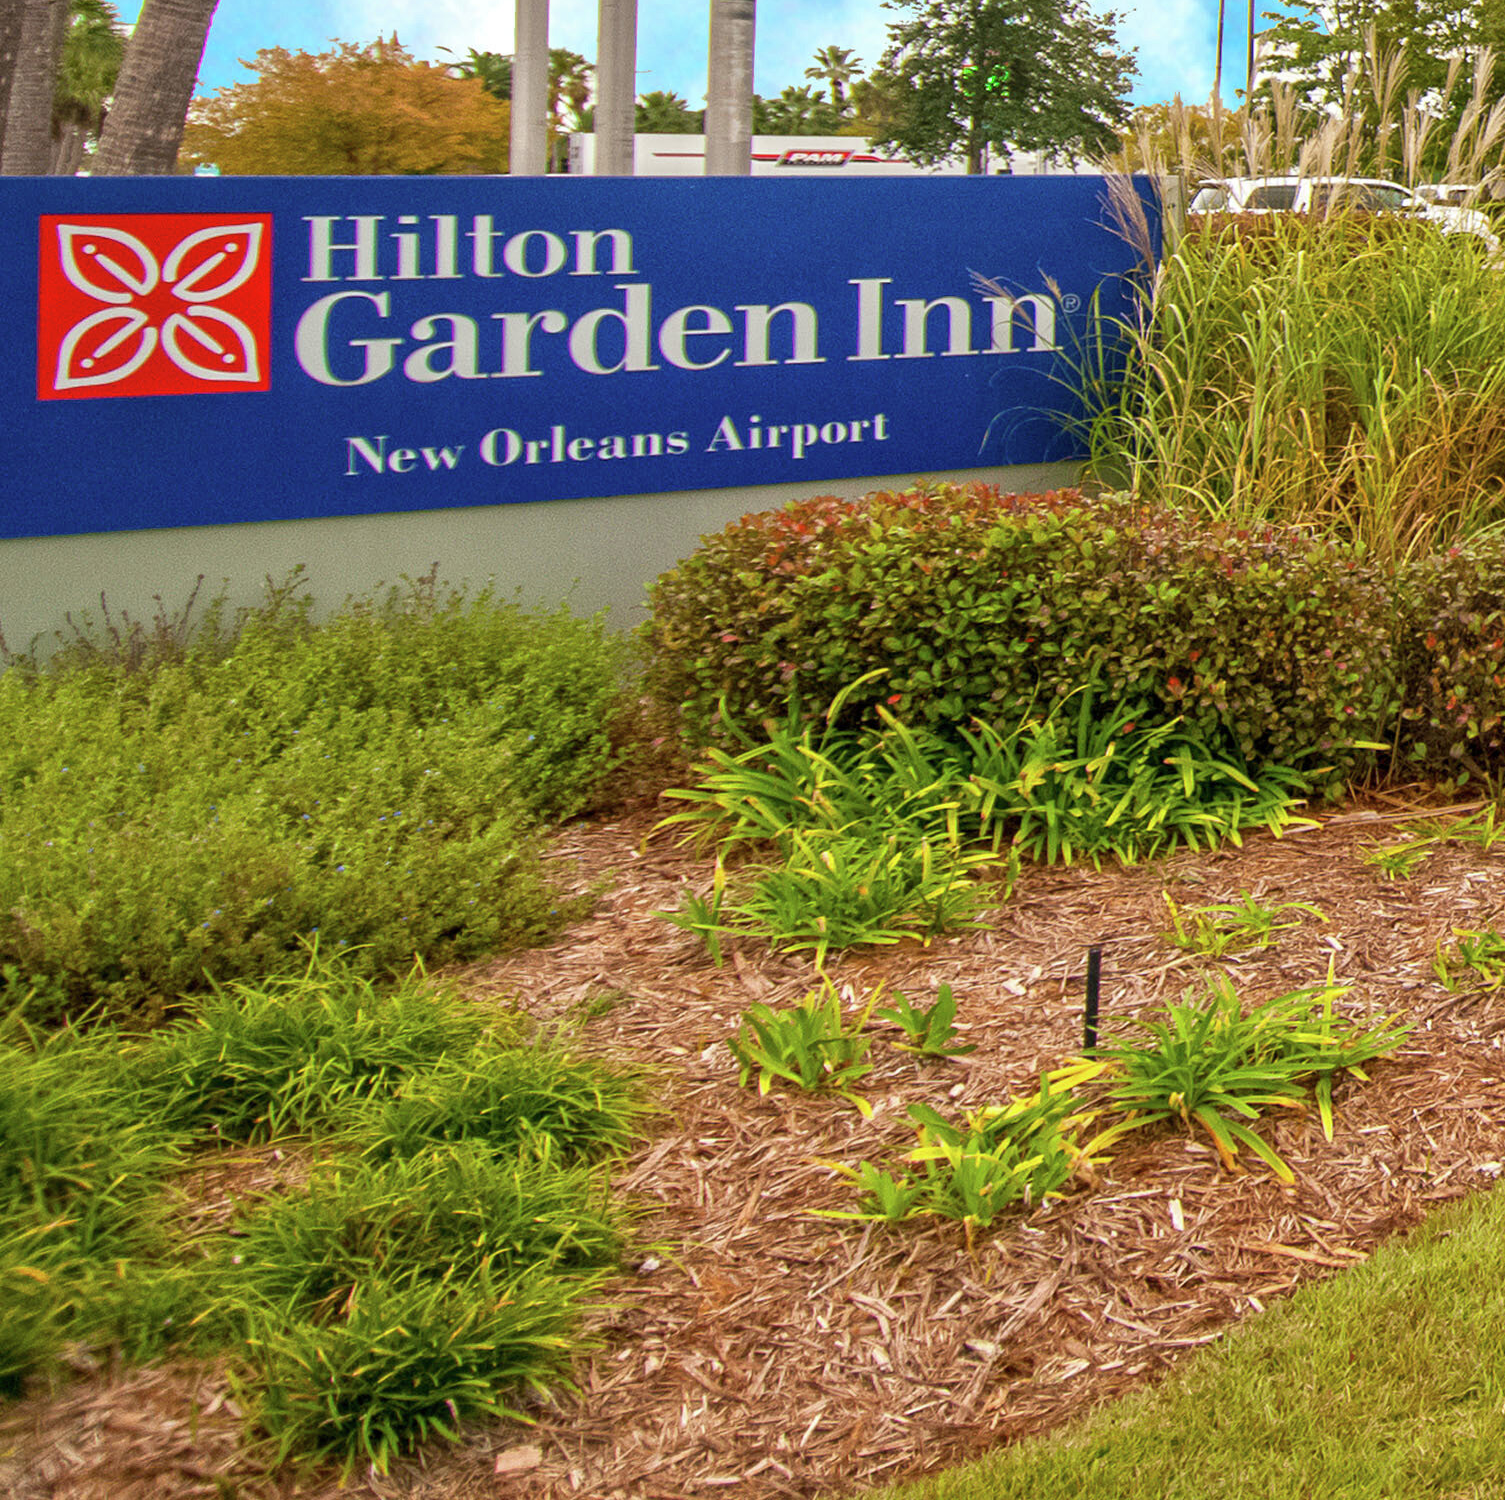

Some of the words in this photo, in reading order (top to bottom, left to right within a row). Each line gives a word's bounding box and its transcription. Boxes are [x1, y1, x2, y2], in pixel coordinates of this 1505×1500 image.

[789, 153, 846, 162] PAM
[300, 214, 640, 282] Hilton
[294, 283, 826, 386] Garden
[846, 277, 1064, 361] Inn
[344, 434, 464, 476] New
[479, 425, 691, 466] Orleans
[705, 413, 890, 459] Airport
